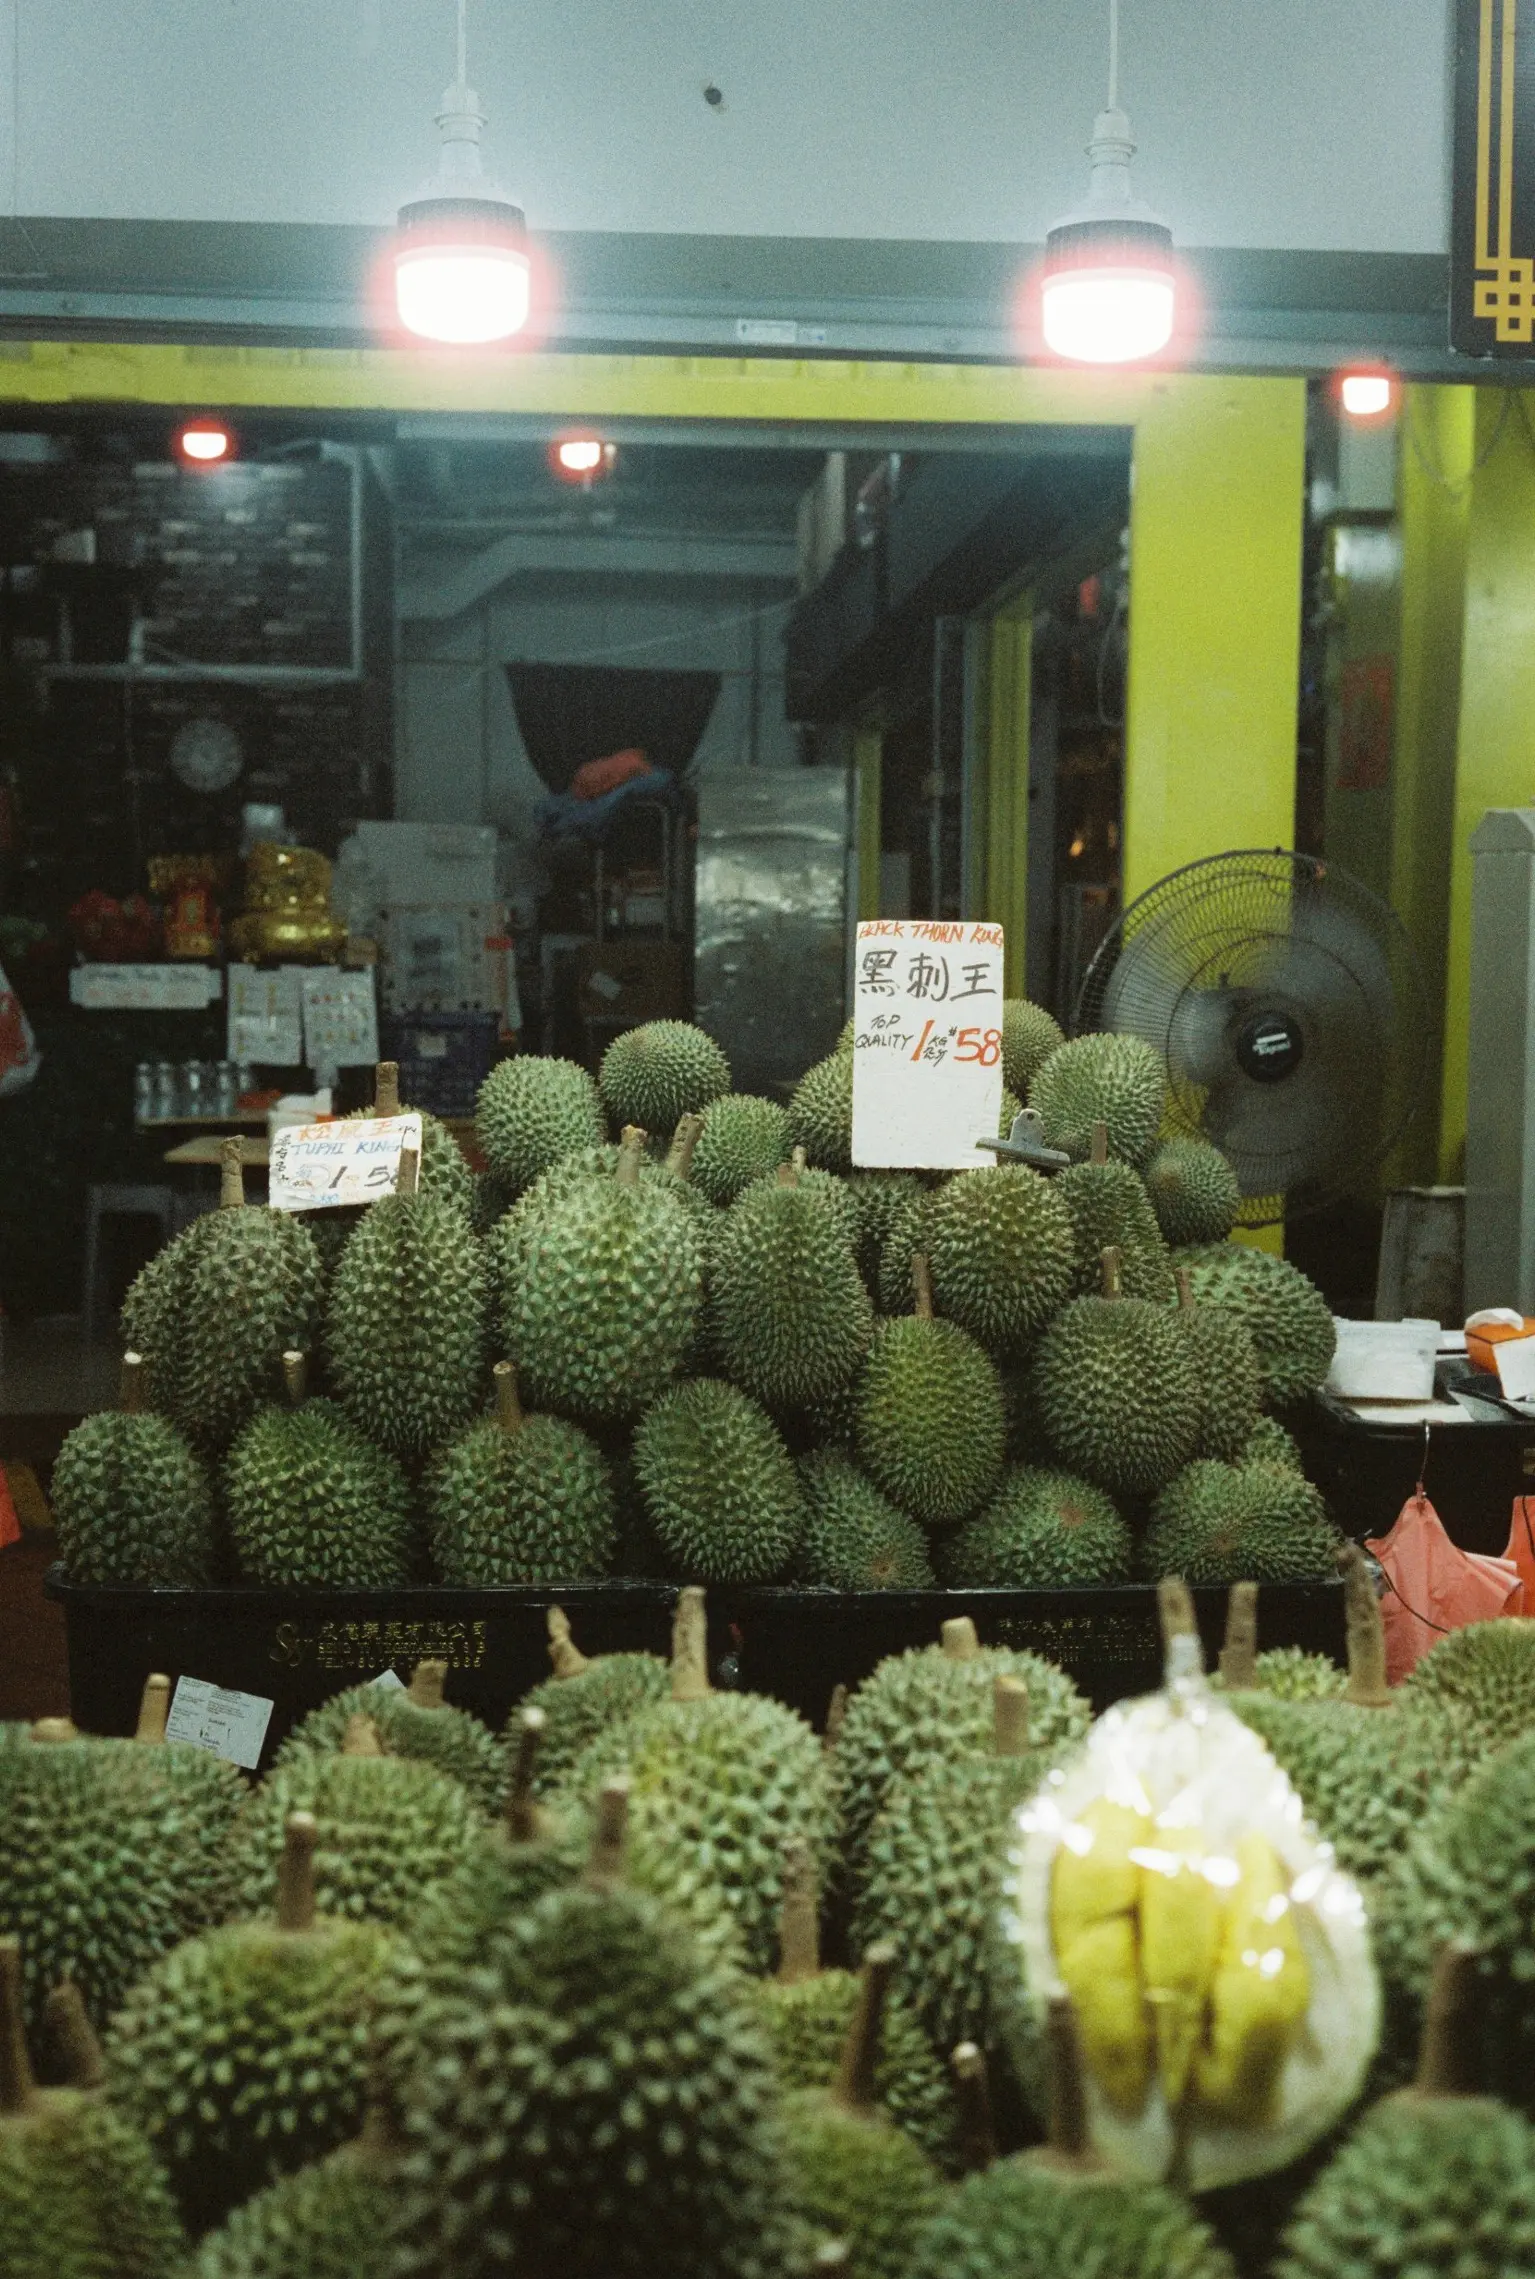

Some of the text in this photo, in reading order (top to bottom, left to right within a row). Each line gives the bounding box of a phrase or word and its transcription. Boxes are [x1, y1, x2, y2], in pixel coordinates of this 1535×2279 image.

[859, 921, 905, 940] BLACK
[911, 923, 965, 944] THORN
[859, 949, 997, 1002] 黑刺王
[871, 1014, 901, 1030] TOP
[855, 1033, 915, 1051] QUALITY
